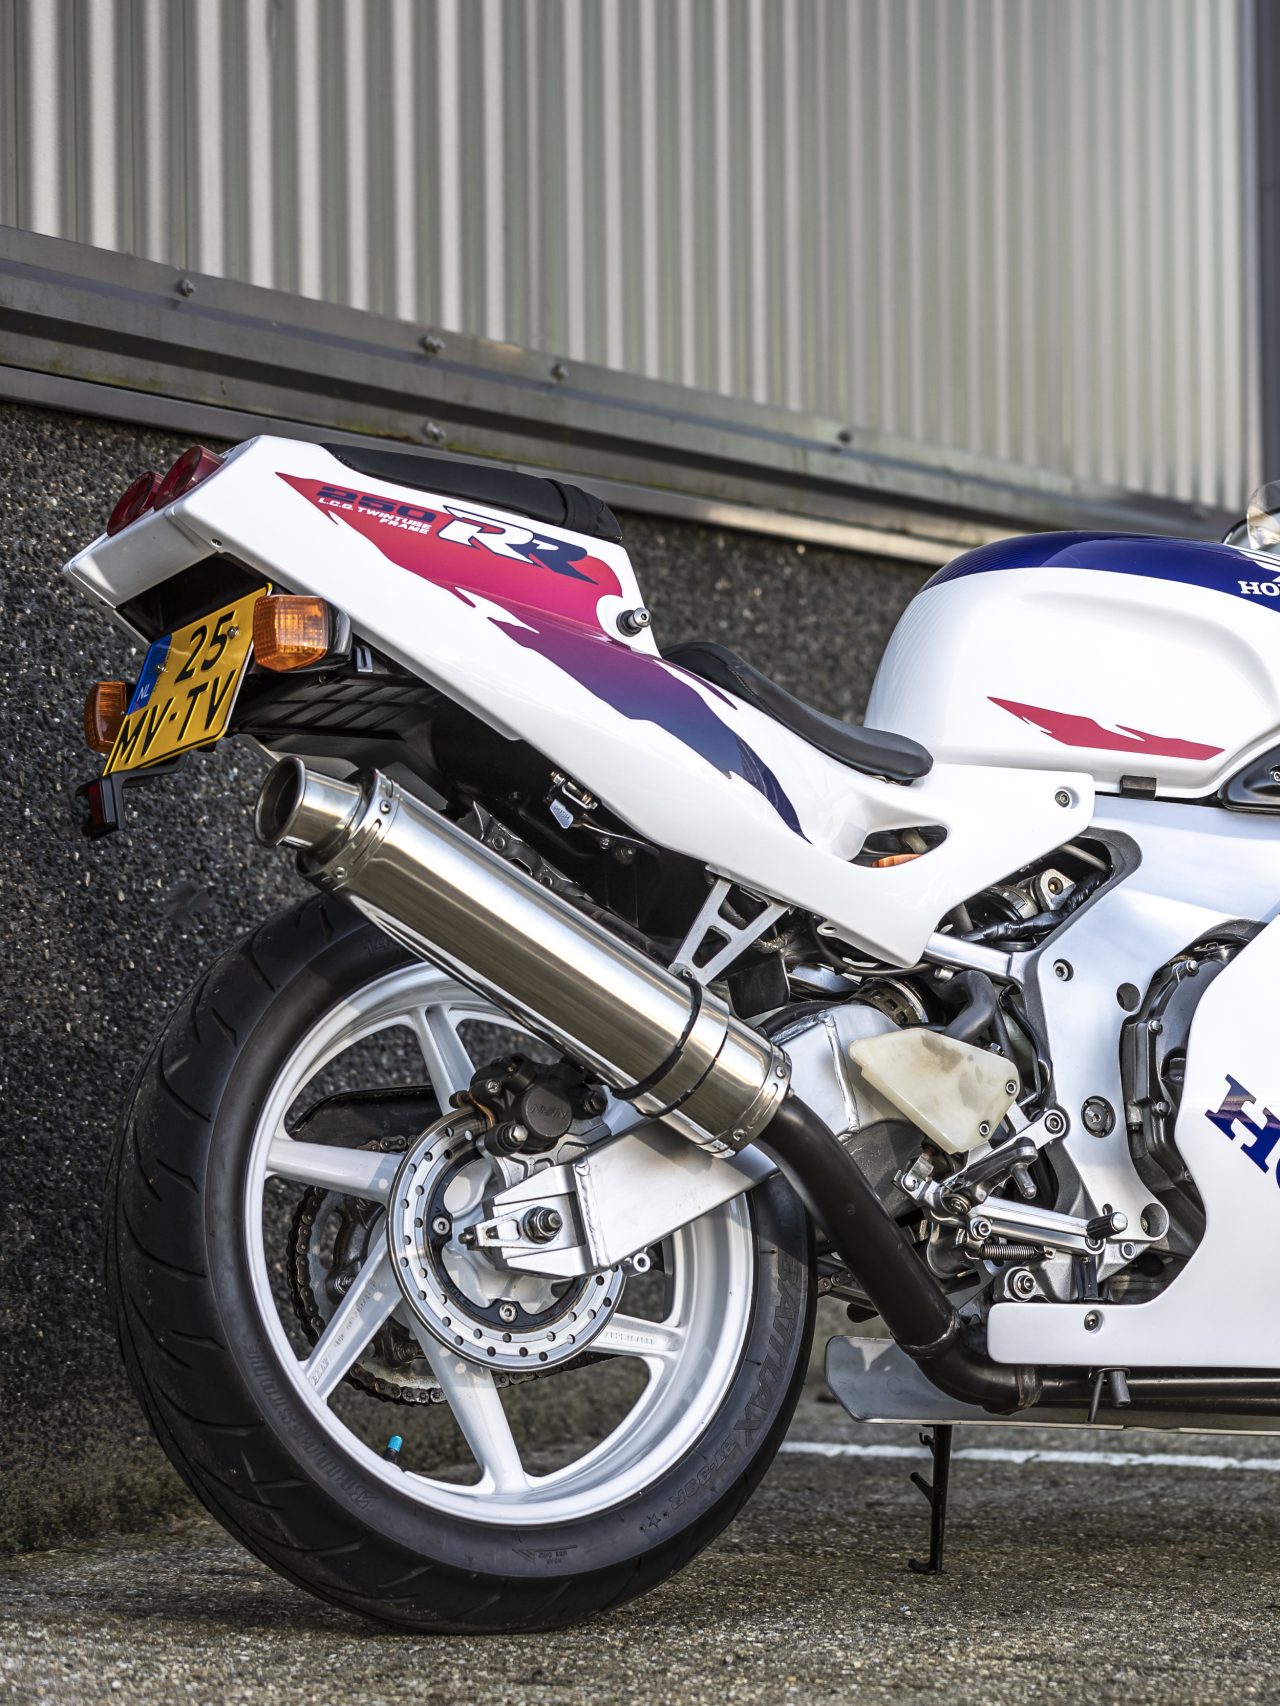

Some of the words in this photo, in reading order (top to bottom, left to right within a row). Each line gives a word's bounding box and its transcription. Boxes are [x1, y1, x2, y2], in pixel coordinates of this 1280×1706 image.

[316, 485, 437, 523] 250
[437, 503, 600, 586] RR
[357, 506, 432, 531] TWINTUBE
[379, 517, 431, 535] FRAME
[174, 610, 237, 685] 25
[118, 668, 239, 766] MV-TV
[136, 682, 151, 703] NL
